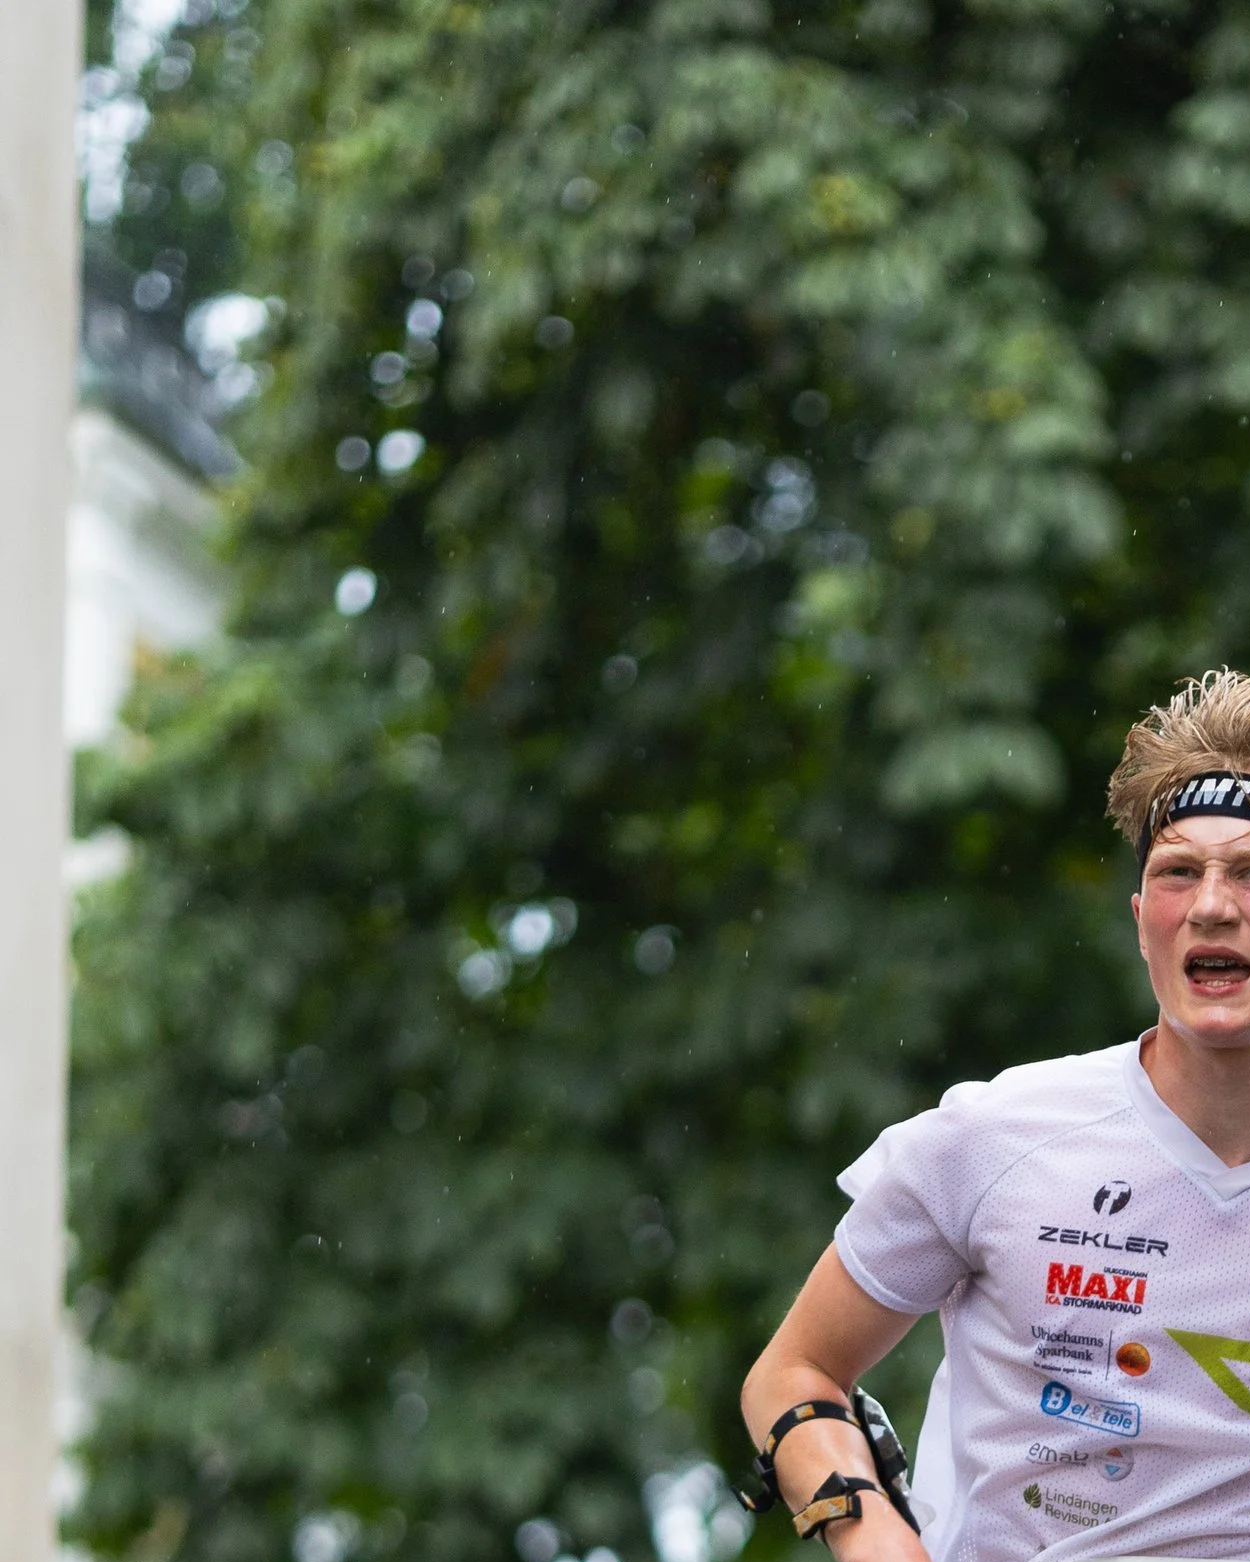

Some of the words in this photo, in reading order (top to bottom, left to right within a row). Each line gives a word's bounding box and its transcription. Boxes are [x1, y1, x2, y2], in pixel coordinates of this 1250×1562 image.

[1038, 1225, 1169, 1257] ZEKLER
[1046, 1262, 1147, 1305] MAXI
[1045, 1294, 1061, 1306] ICA
[1062, 1296, 1143, 1315] STORMARKNAD
[1035, 1342, 1093, 1361] Sparbank
[1045, 1487, 1118, 1515] Lindängen
[1045, 1503, 1099, 1527] Revision
